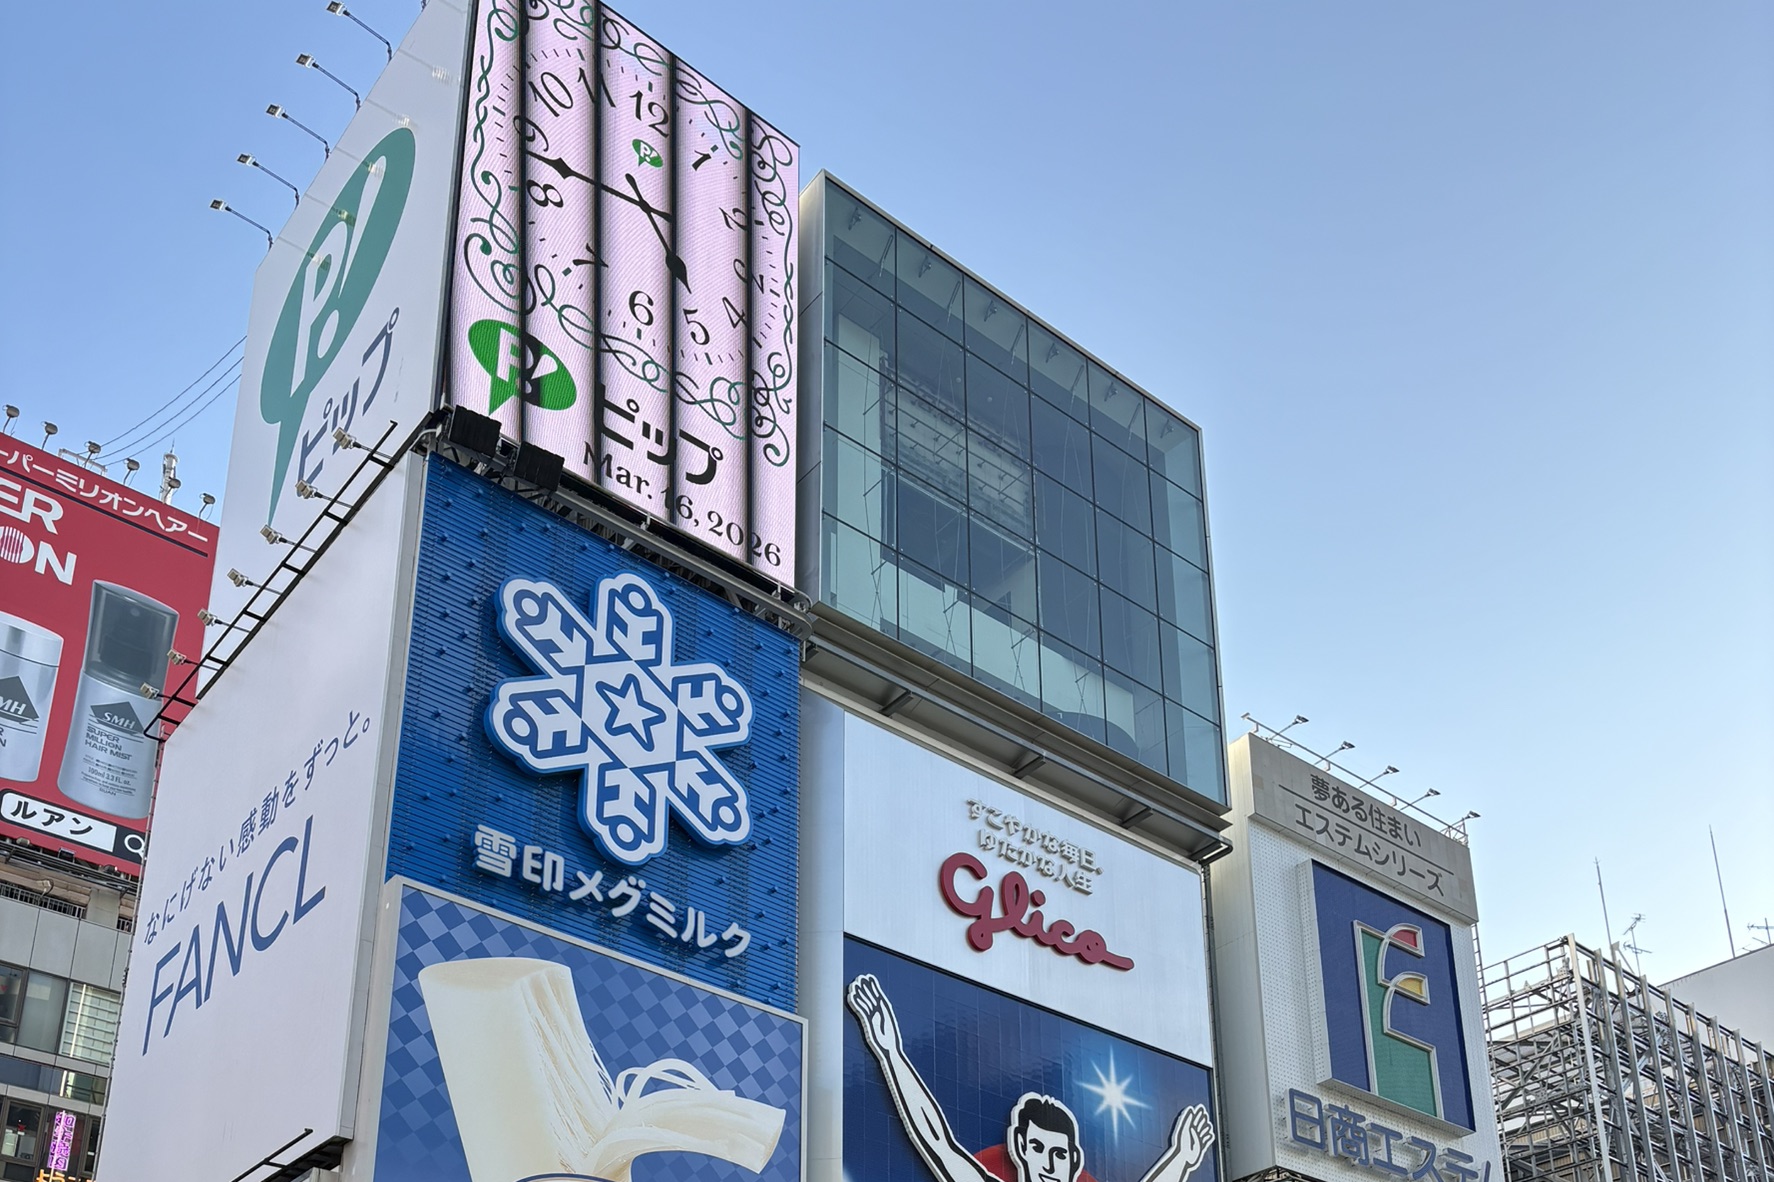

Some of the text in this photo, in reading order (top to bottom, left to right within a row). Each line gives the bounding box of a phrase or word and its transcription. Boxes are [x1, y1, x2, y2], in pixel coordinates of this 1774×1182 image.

[527, 72, 574, 118] 10
[630, 90, 669, 138] 12
[527, 179, 564, 208] 8
[628, 290, 654, 326] 6
[683, 307, 710, 346] 5
[721, 296, 748, 329] 4
[297, 306, 400, 497] ピップ
[599, 384, 724, 485] ピップ
[584, 441, 653, 499] Mar.
[707, 510, 781, 568] 2026
[86, 732, 122, 751] MILLION
[87, 726, 119, 743] SUPER
[103, 712, 136, 729] SMH
[85, 739, 132, 760] HAIR MIST
[11, 800, 93, 835] ルアン
[144, 710, 370, 945] なにげない感動をずっと。
[1311, 775, 1422, 849] 夢ある住まい
[978, 829, 1093, 894] ゆたかな人生
[1295, 804, 1445, 896] エステムシリーズ
[474, 824, 751, 958] 雪印メグミルク
[940, 852, 1134, 970] Glico
[142, 814, 326, 1056] FANCL
